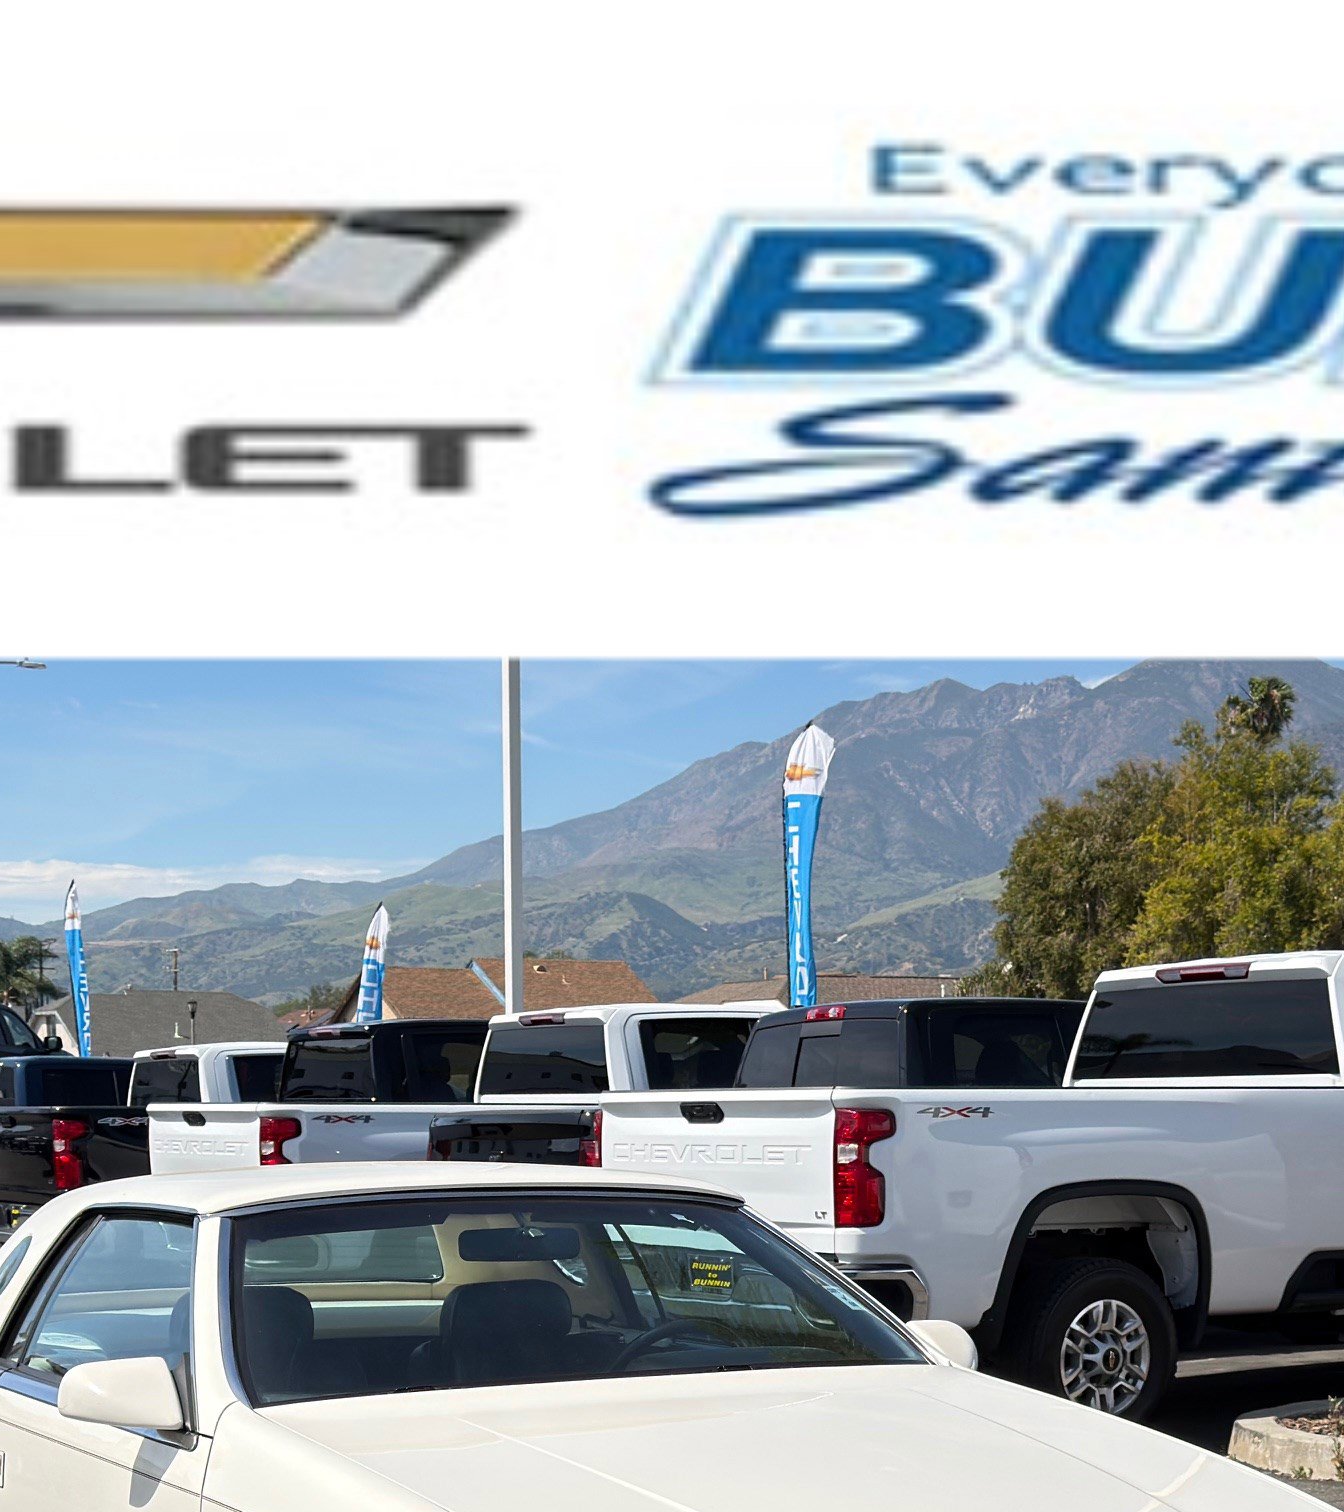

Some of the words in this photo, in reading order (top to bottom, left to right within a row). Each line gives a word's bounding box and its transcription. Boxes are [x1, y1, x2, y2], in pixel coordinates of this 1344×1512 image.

[154, 1139, 250, 1157] CHEVROLET
[611, 1143, 812, 1166] CHEVROLET
[814, 1211, 827, 1219] LT
[692, 1262, 731, 1271] RUNNIN'
[693, 1279, 731, 1287] BUNNIN
